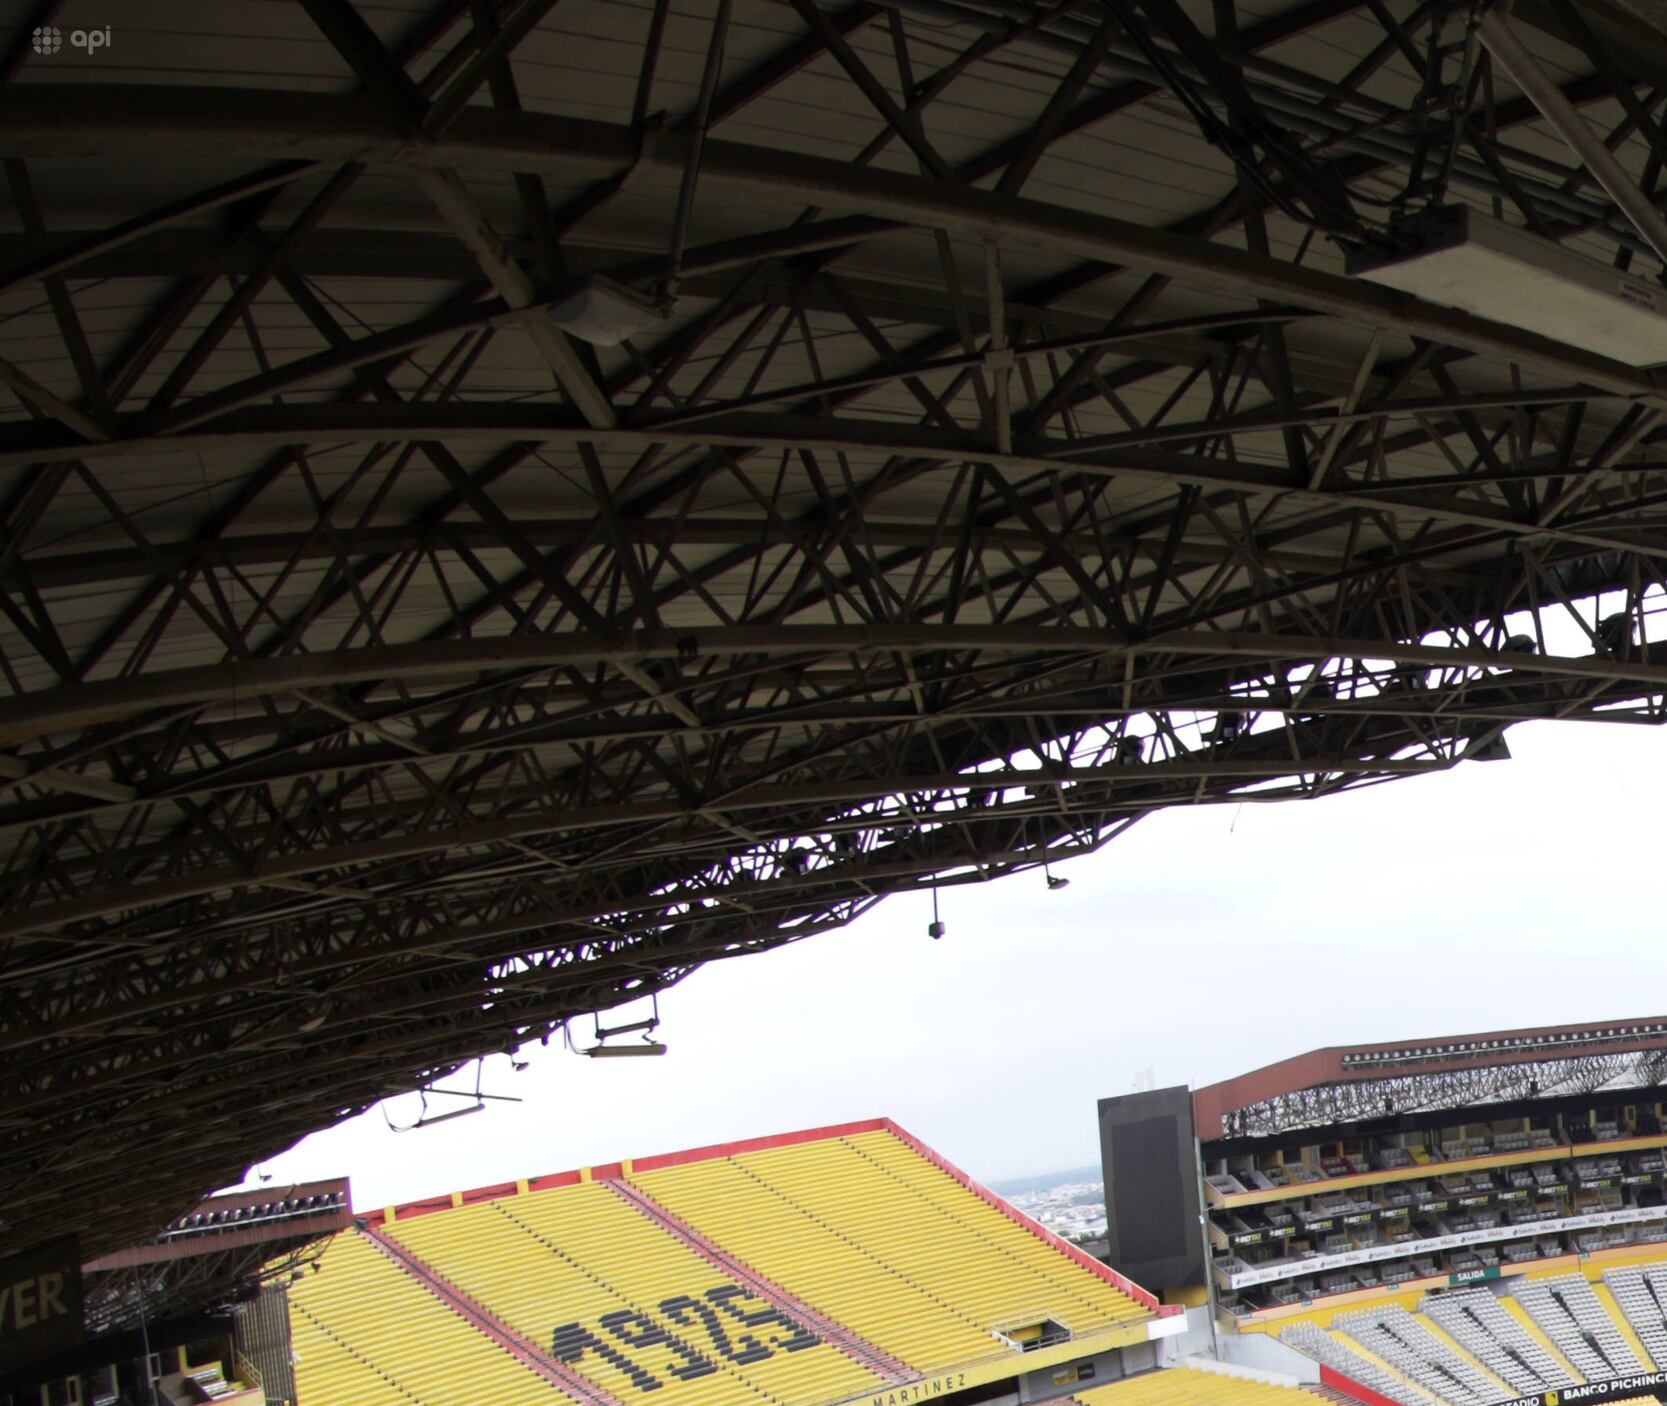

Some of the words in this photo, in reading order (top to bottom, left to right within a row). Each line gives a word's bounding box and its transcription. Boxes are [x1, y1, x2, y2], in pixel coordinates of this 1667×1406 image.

[1457, 1269, 1486, 1282] SALIDA
[551, 1284, 822, 1393] 1925
[1563, 1381, 1608, 1400] BANCO
